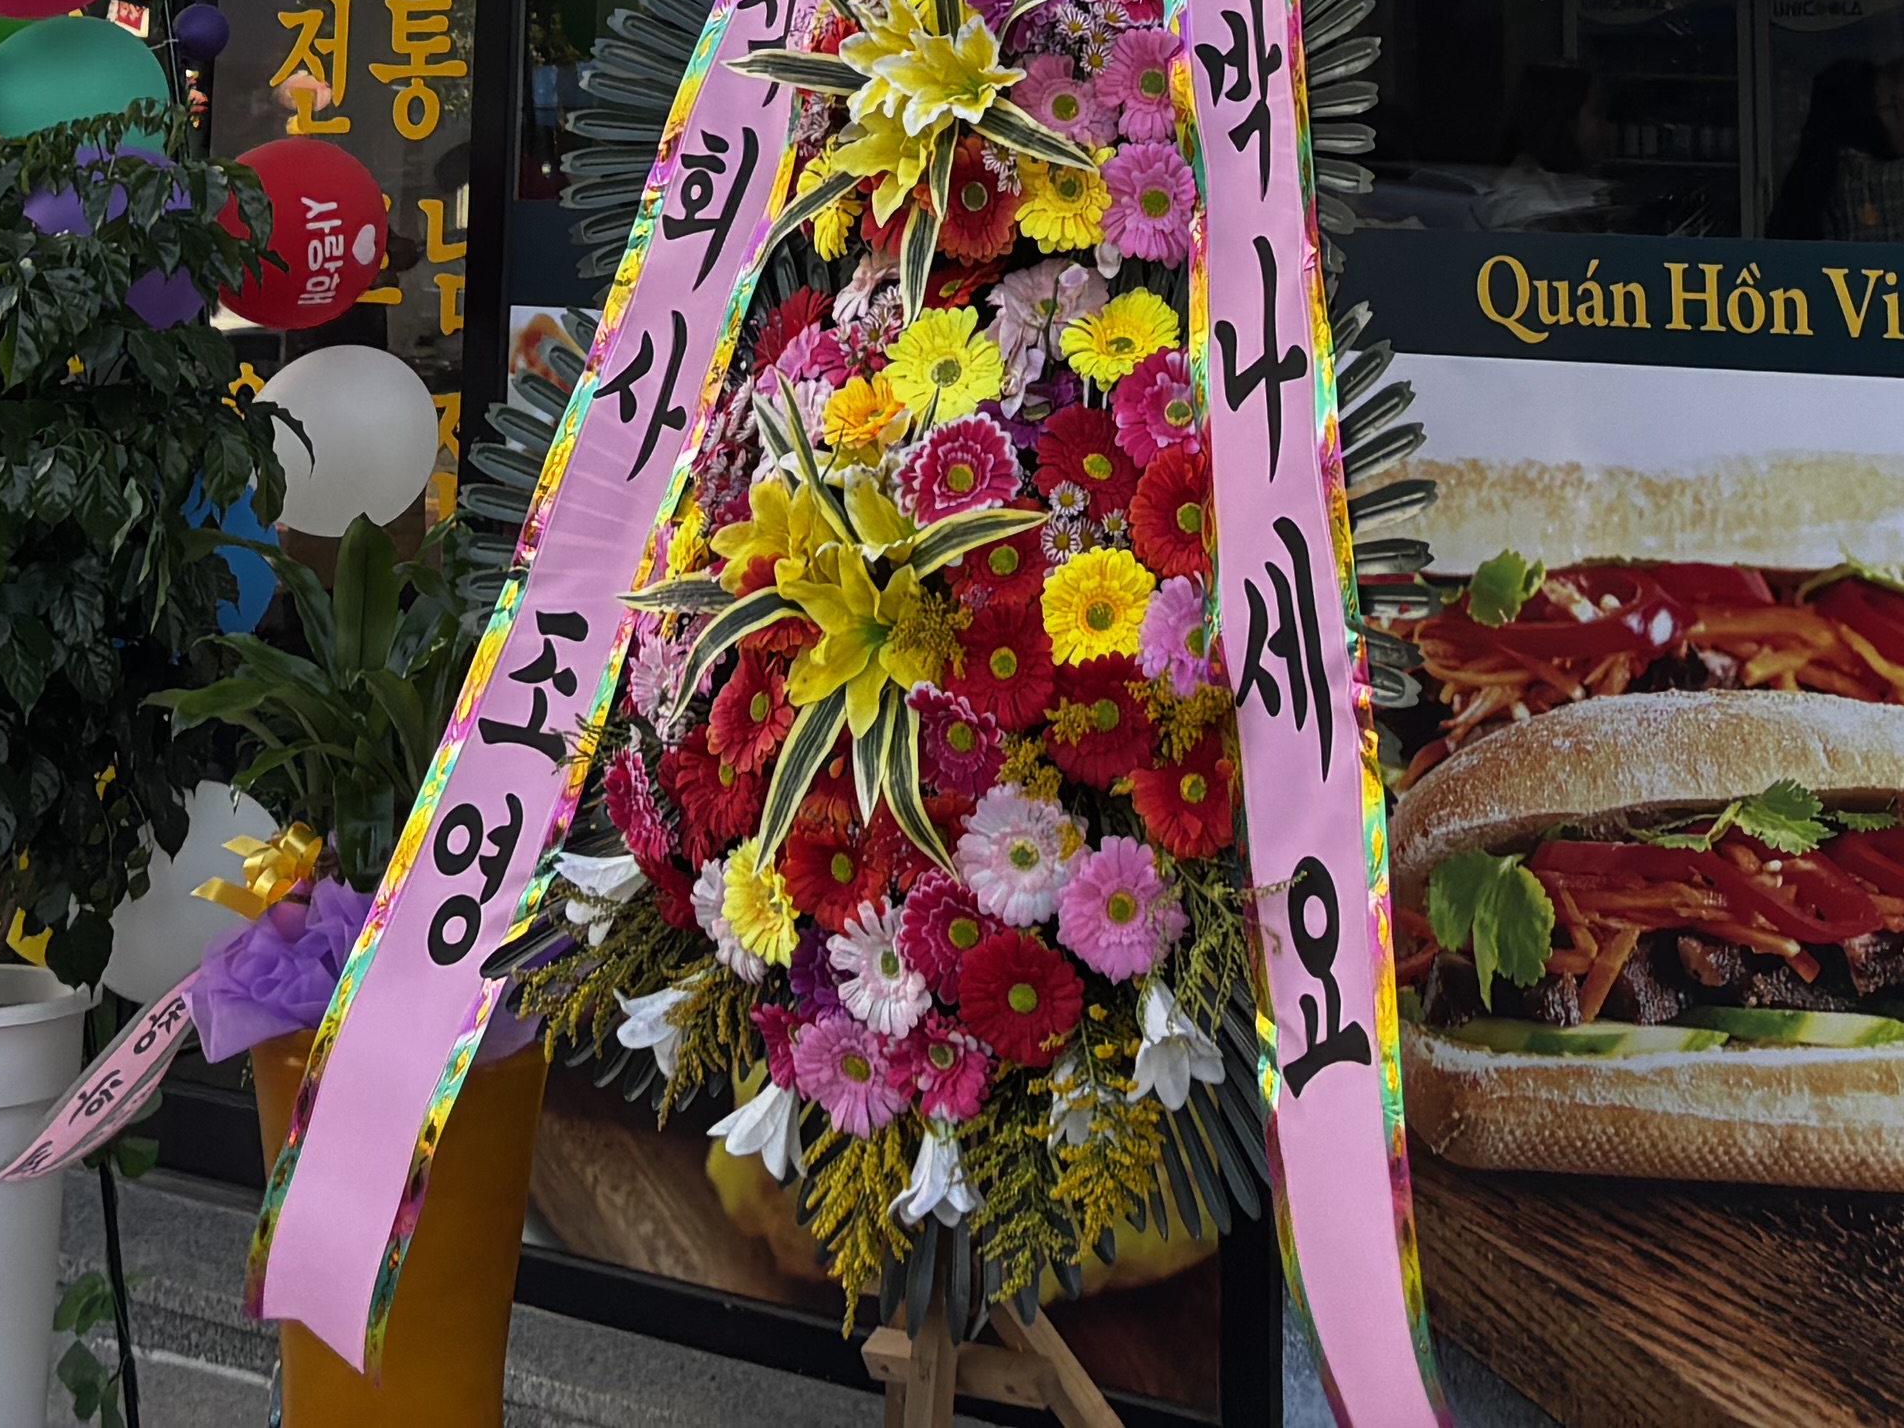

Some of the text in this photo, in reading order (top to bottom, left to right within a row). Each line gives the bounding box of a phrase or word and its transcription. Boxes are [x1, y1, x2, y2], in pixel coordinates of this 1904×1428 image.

[297, 194, 346, 309] 사랑해
[1477, 254, 1651, 344] Quán
[1663, 262, 1814, 336] Hồn
[426, 610, 589, 968] 조영
